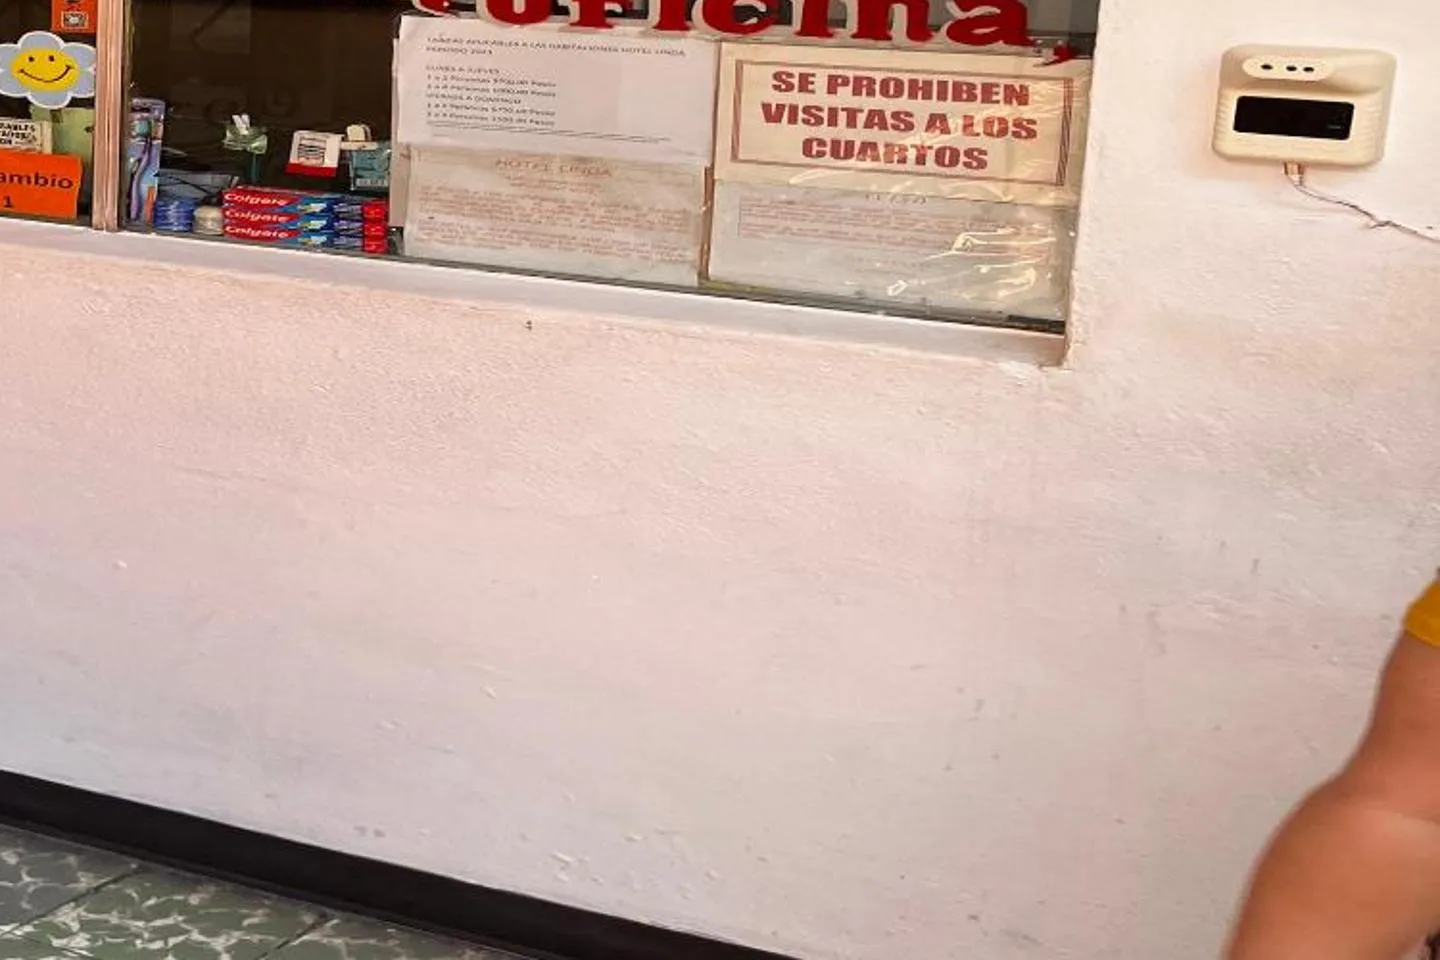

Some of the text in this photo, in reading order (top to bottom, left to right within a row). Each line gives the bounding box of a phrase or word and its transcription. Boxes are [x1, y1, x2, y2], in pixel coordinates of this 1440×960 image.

[772, 70, 1031, 107] SE PROHIBEN
[761, 102, 1039, 140] VISITAS A LOS
[801, 137, 989, 170] CUARTOS
[3, 195, 14, 208] 1
[224, 193, 290, 206] Colgate
[224, 207, 290, 223] Colgate
[224, 224, 291, 239] Colgate
